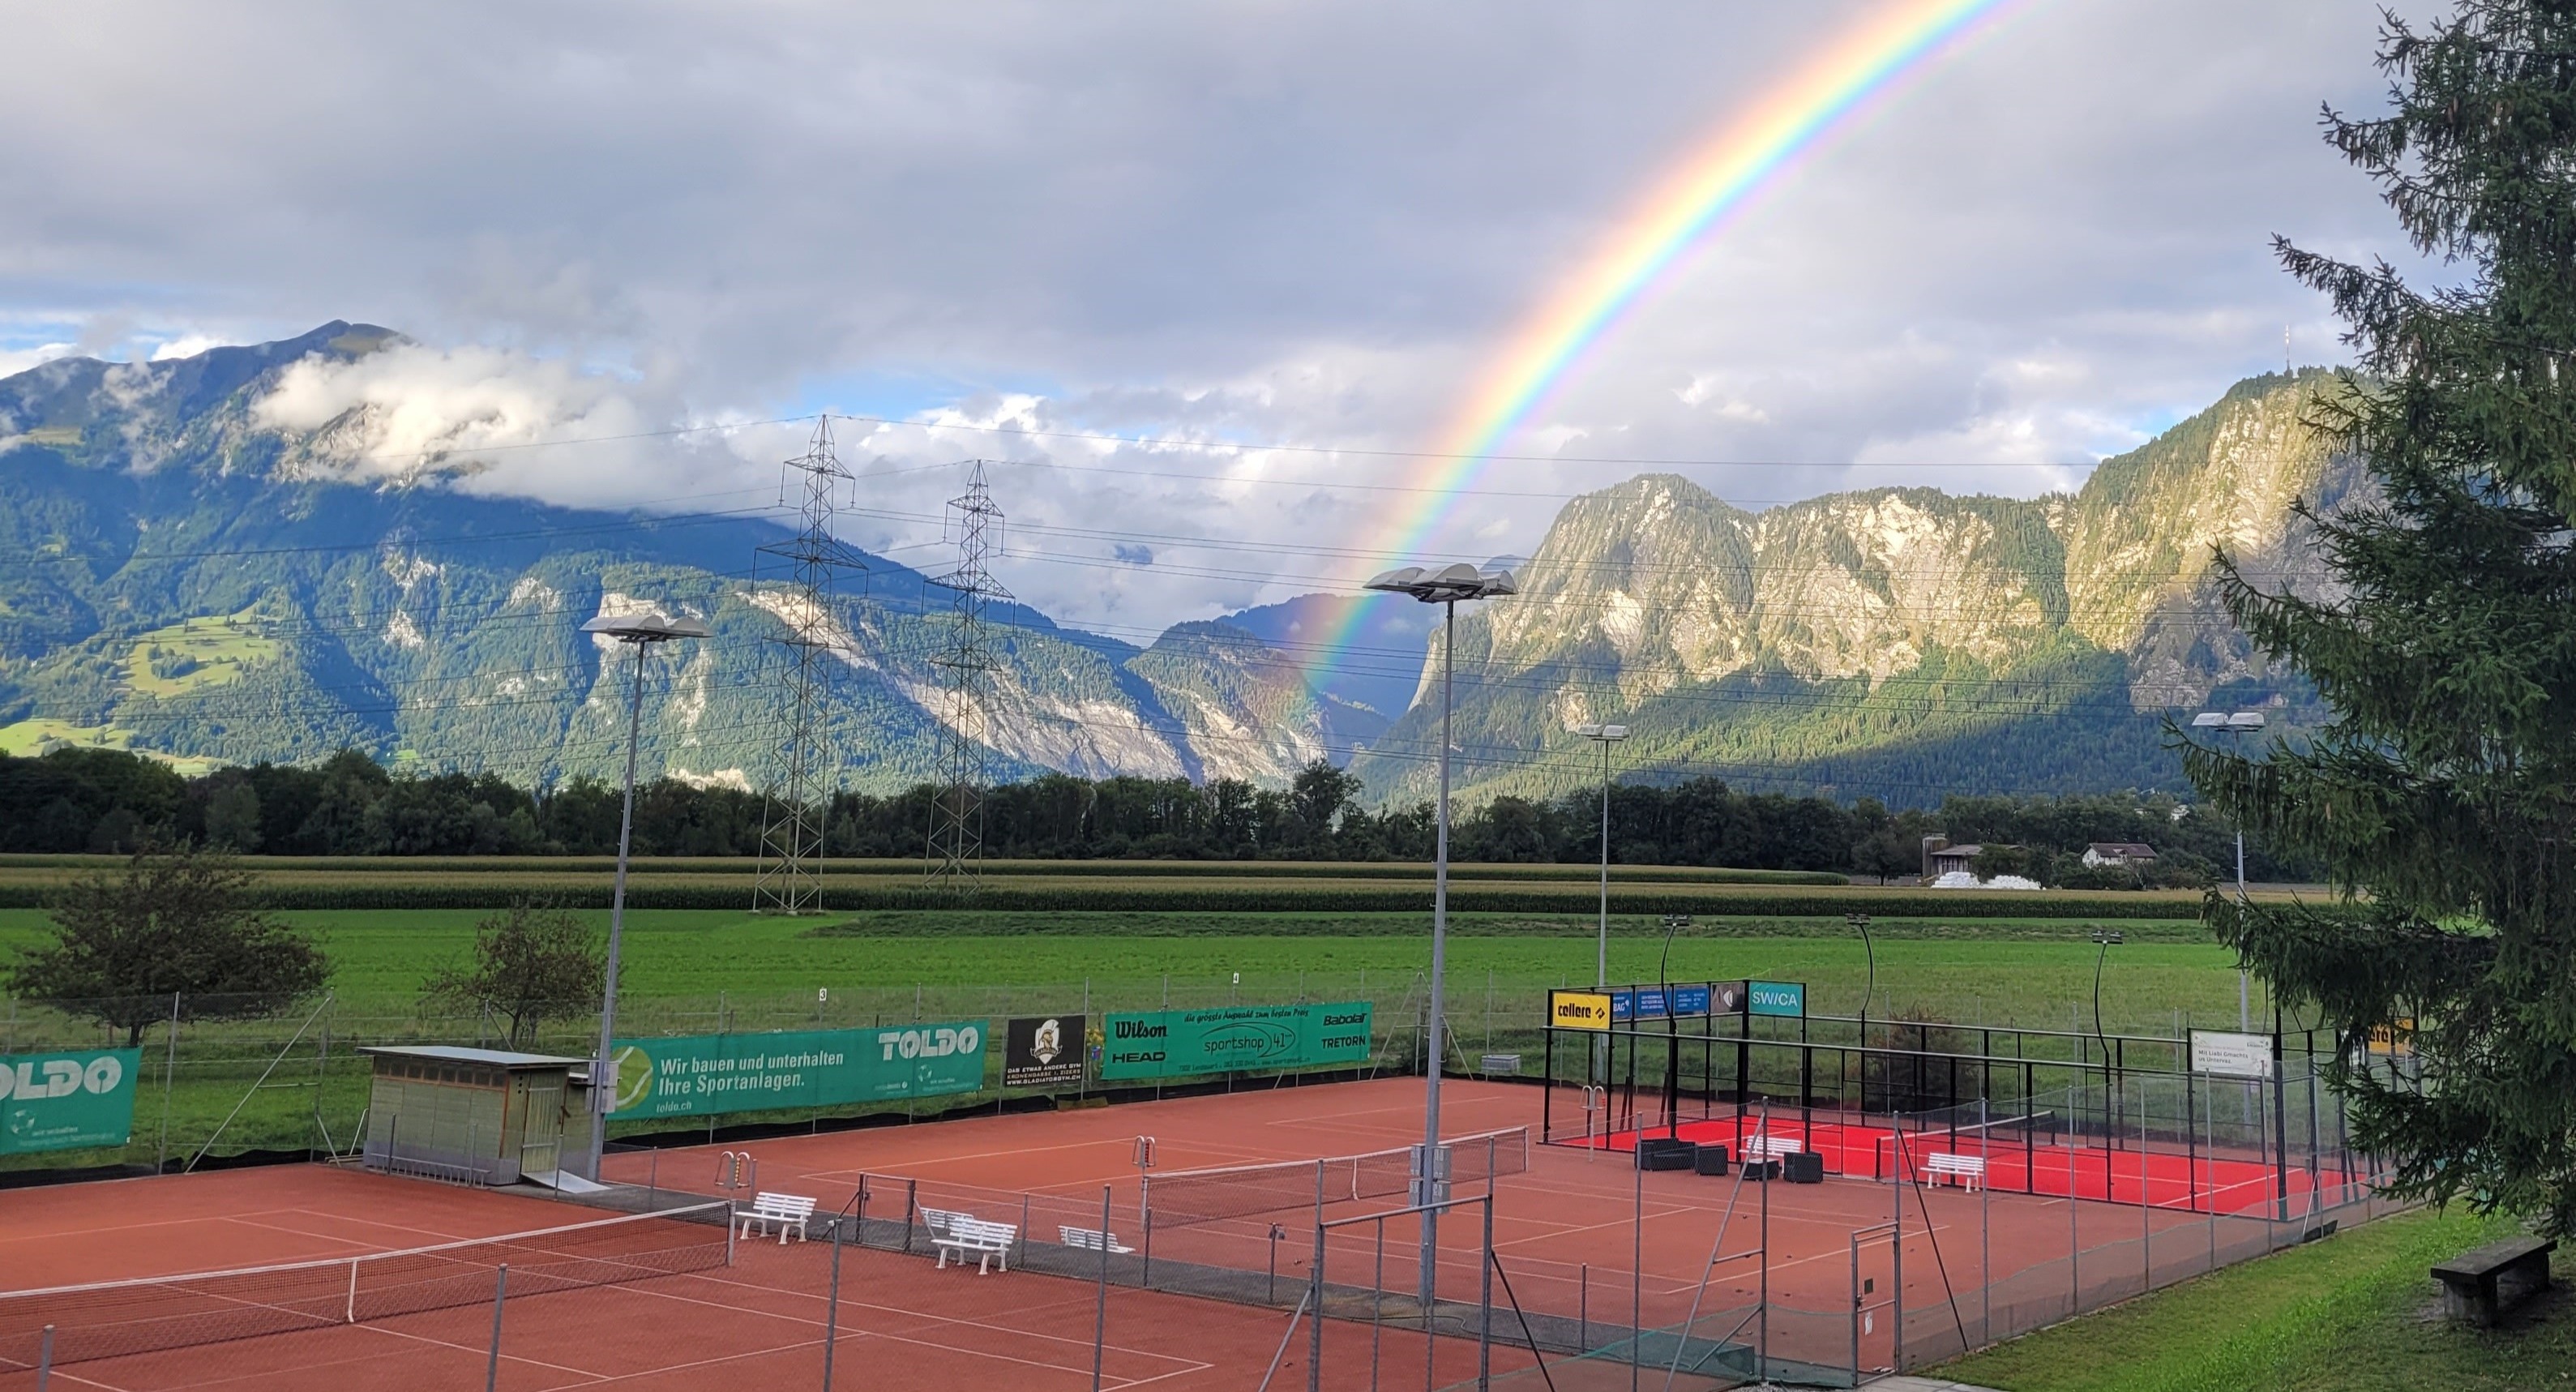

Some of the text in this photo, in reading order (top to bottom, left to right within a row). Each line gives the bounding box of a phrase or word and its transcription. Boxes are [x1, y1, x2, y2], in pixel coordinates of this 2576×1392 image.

[820, 990, 826, 1000] 3
[1557, 1002, 1591, 1019] cellere
[1115, 1020, 1168, 1039] Wilson
[879, 1026, 979, 1061] TOLDO
[1203, 1032, 1286, 1056] sportshop 41
[1321, 1035, 1367, 1049] TRETORN
[661, 1050, 844, 1076] Wir bauen und unterhalten
[1112, 1051, 1166, 1064] HEAD
[658, 1072, 805, 1097] Ihre Sportanlagen.
[1006, 1074, 1081, 1086] WWW.GLADIATORGYM.CH
[657, 1101, 692, 1113] toldo.ch
